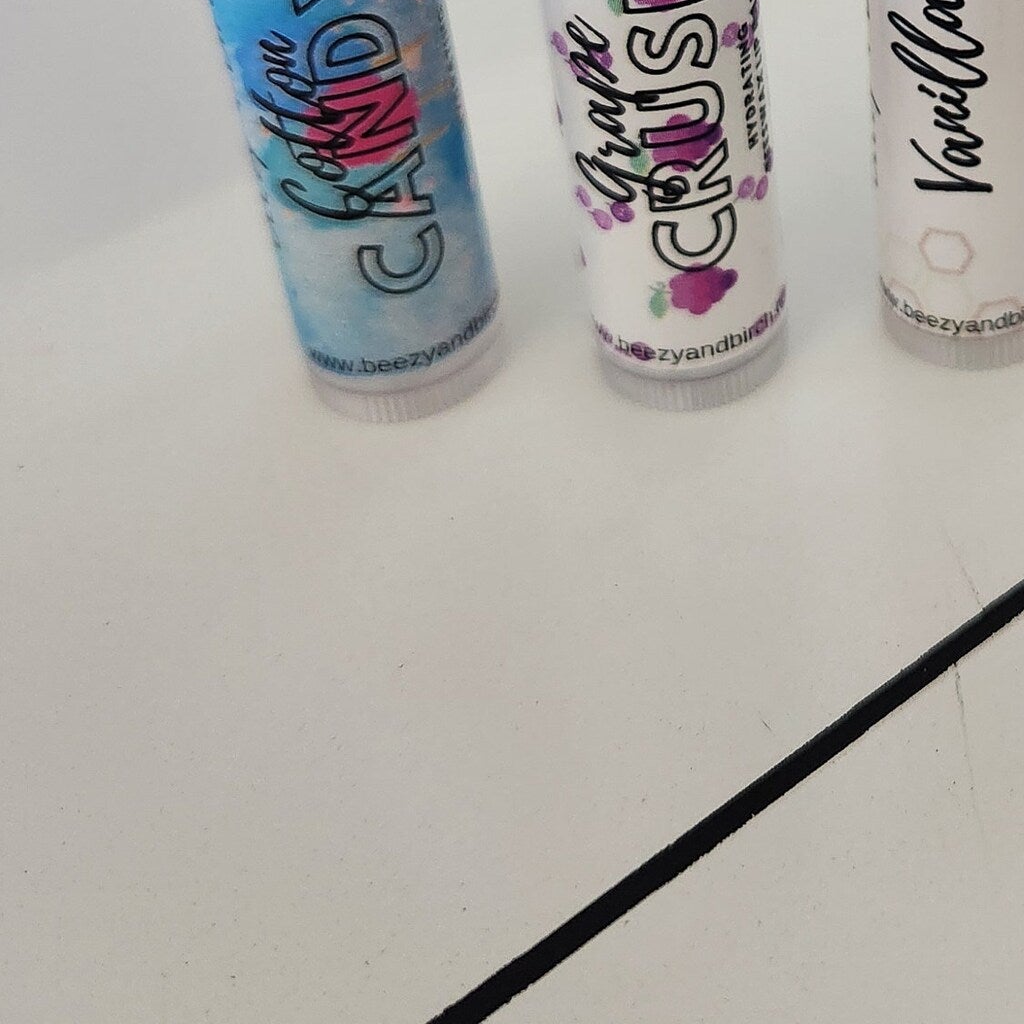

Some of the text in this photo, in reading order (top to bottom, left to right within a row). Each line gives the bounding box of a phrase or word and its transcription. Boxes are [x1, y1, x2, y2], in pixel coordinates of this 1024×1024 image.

[250, 29, 374, 221] Cotton
[565, 13, 685, 204] Grape
[736, 21, 759, 151] HYDRATING
